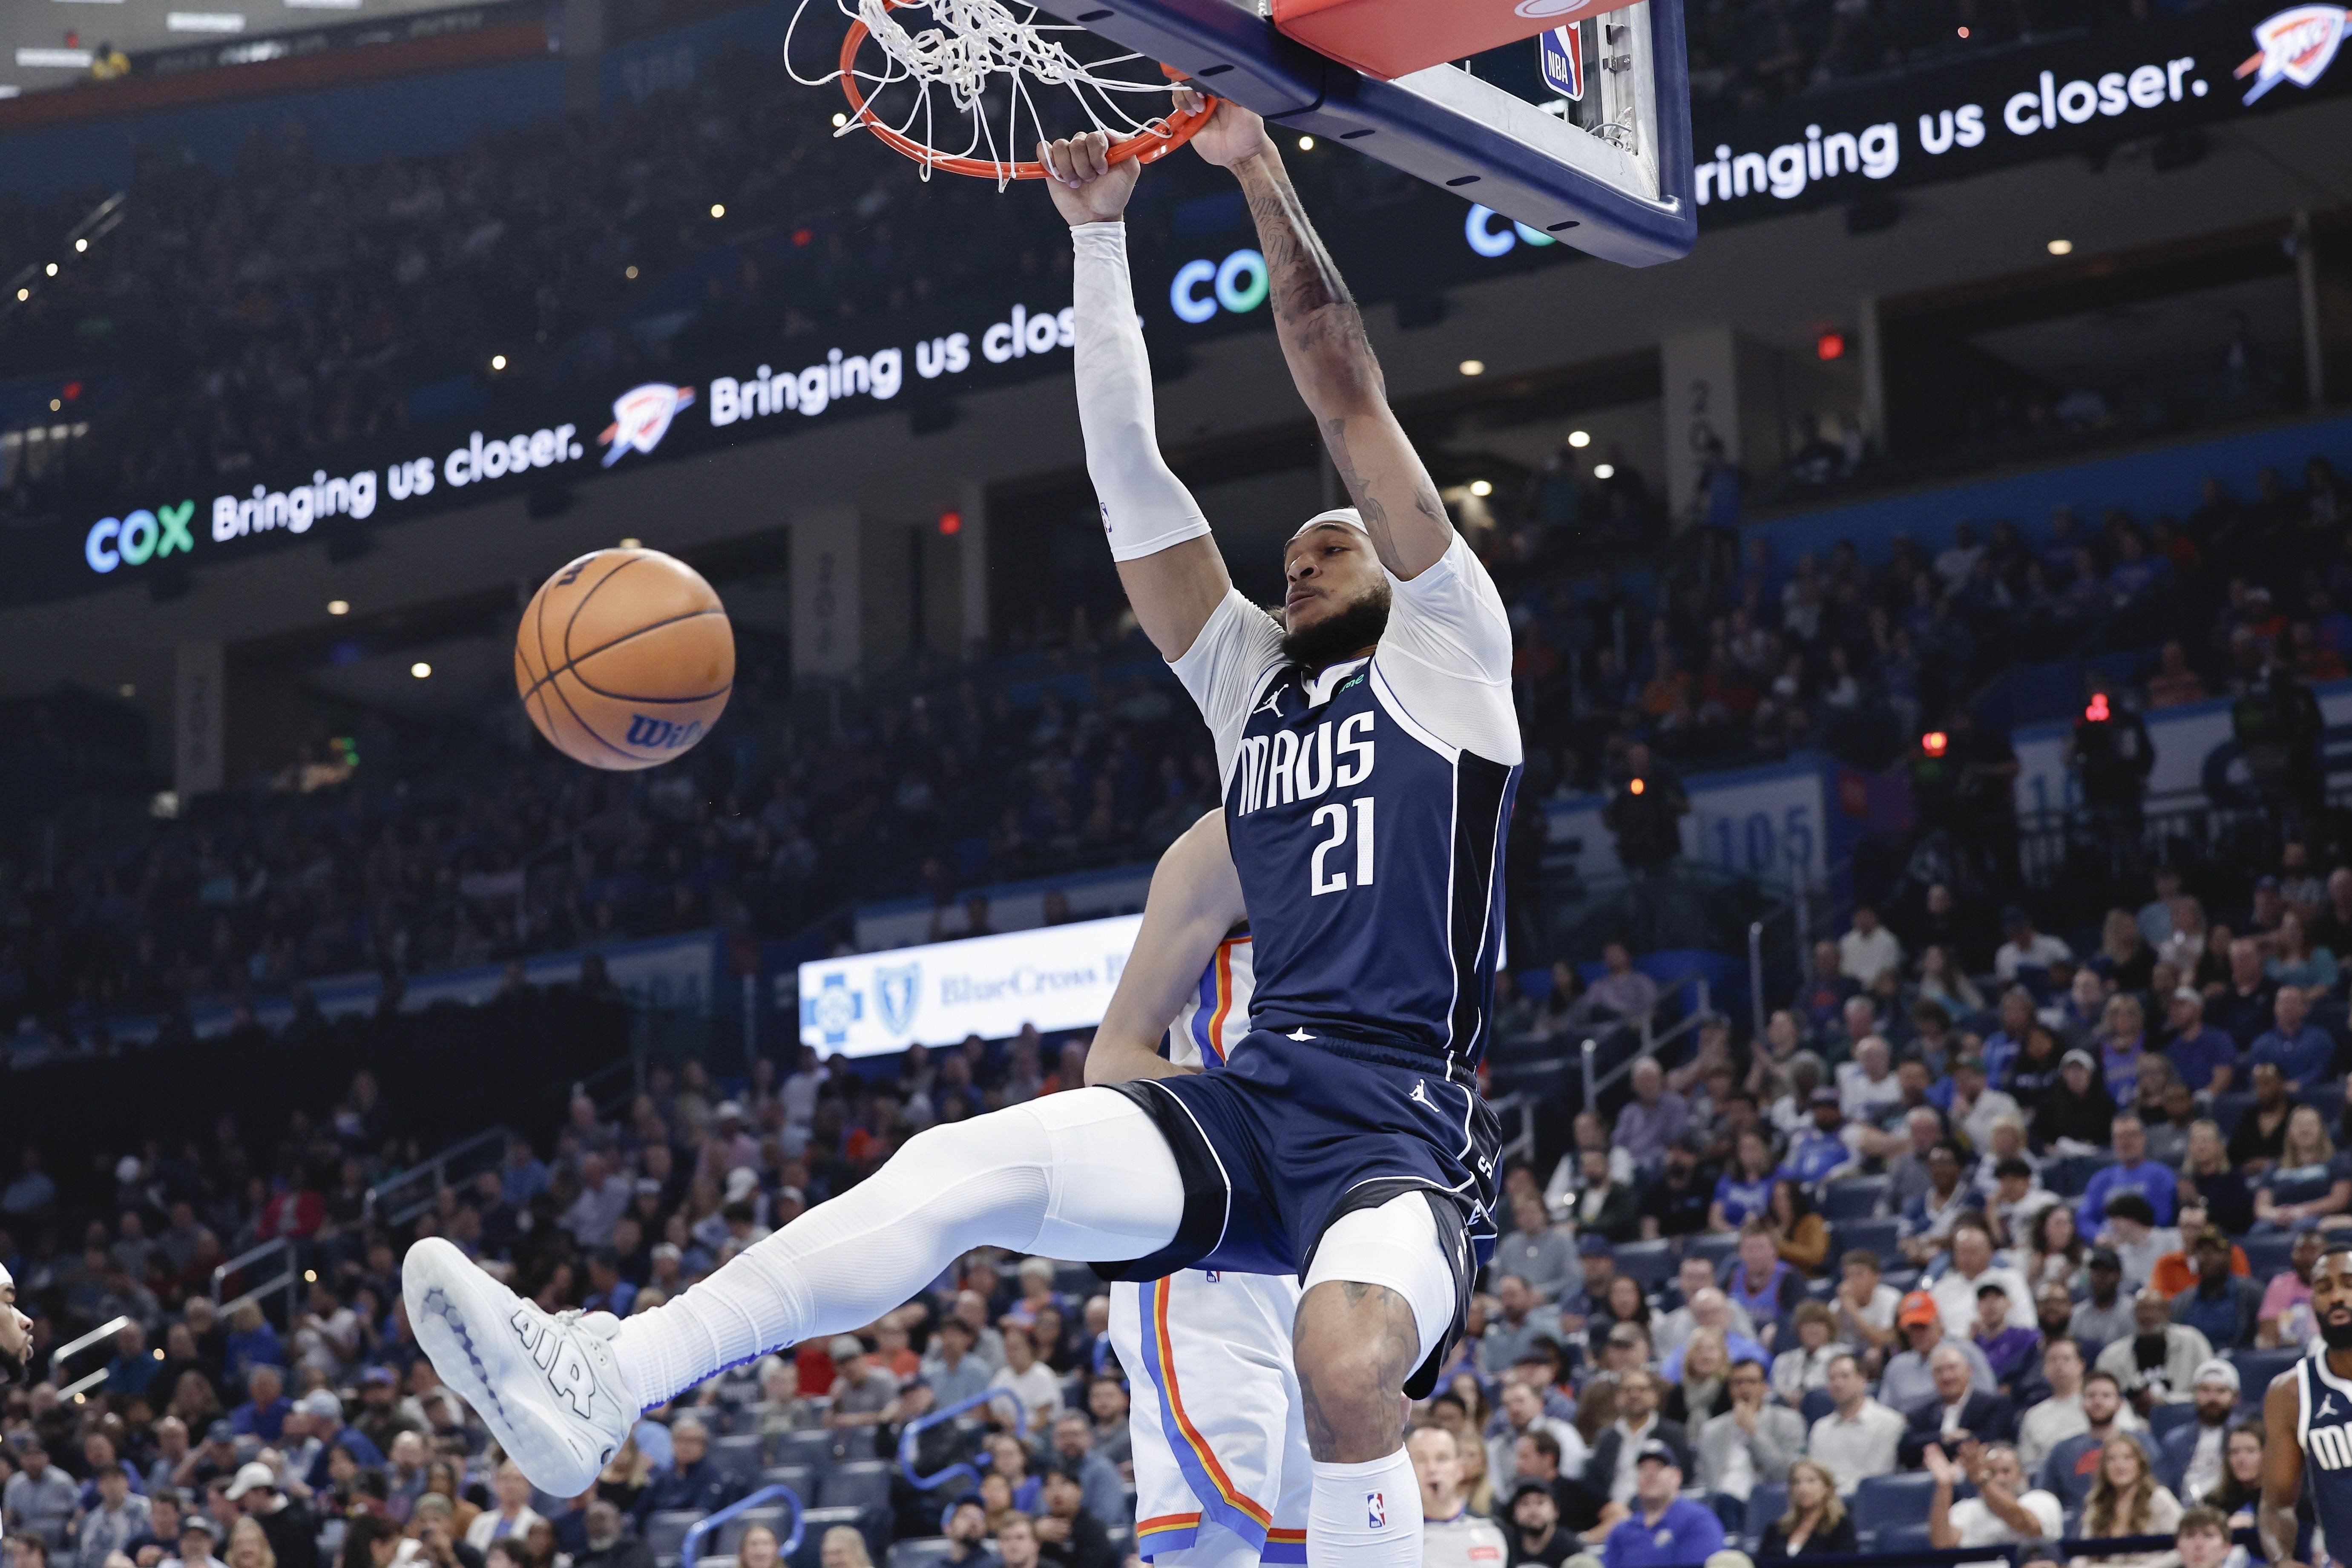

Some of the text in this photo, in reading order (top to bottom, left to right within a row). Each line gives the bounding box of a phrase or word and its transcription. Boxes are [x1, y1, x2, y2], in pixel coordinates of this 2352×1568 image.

[1547, 49, 1568, 85] NBA
[1695, 57, 2208, 205] ringing us closer.
[1170, 248, 1269, 323] CO
[710, 347, 902, 426] Bringing
[915, 332, 971, 379] us
[85, 423, 584, 573] COX Bringing us closer.
[626, 712, 702, 749] Wil
[1238, 711, 1374, 817] MAVS
[1311, 797, 1374, 896] 21
[511, 1309, 595, 1419] AIR
